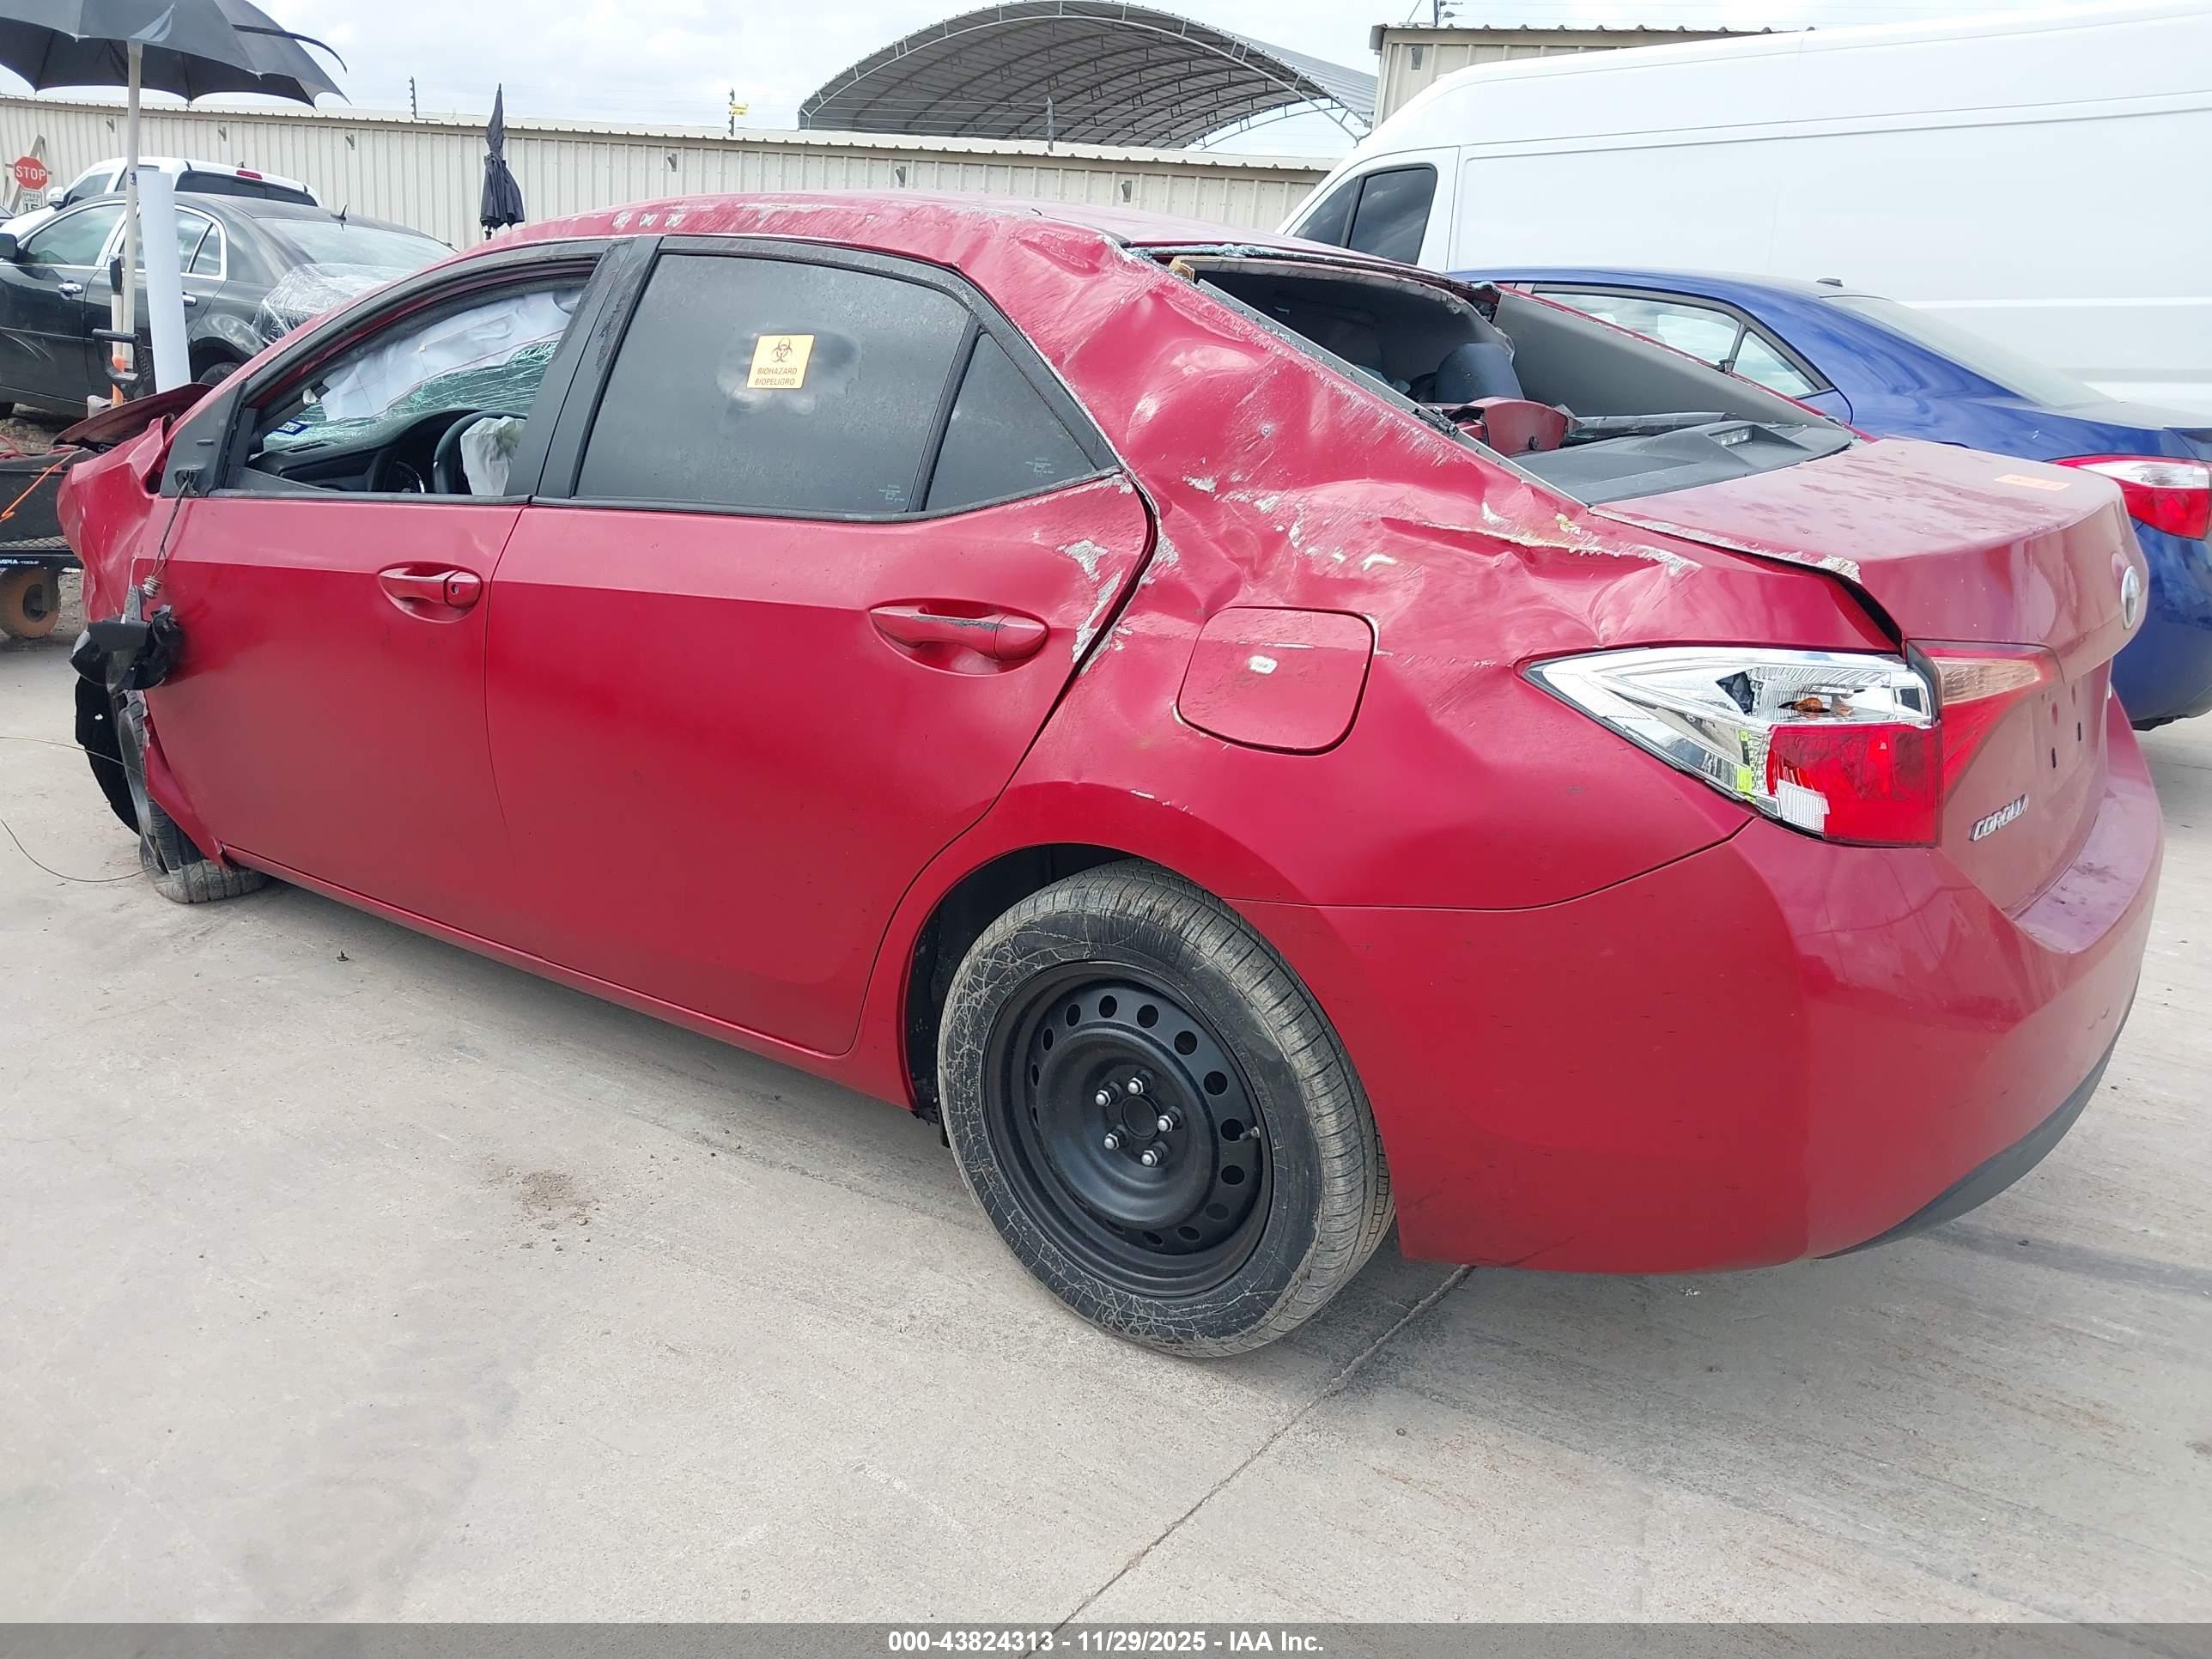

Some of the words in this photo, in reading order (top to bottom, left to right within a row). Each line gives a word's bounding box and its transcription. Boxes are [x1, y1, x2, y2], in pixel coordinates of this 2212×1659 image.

[15, 165, 46, 181] STOP
[757, 367, 798, 375] BIOHAZARD
[1968, 793, 2029, 842] COROLLA
